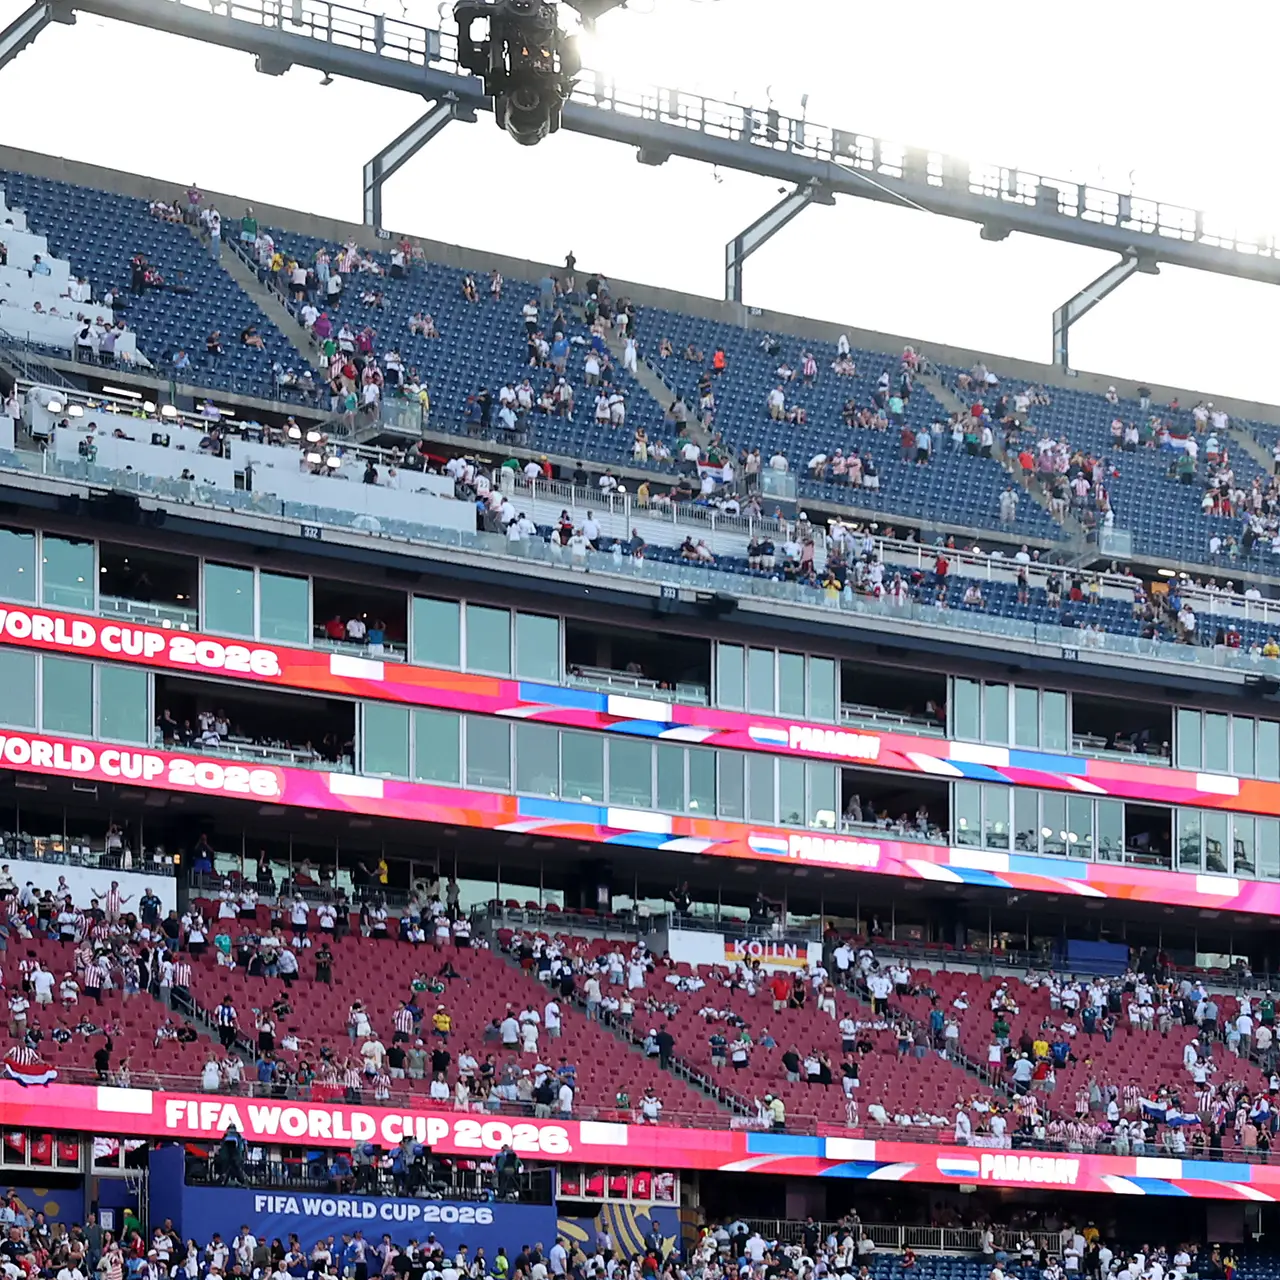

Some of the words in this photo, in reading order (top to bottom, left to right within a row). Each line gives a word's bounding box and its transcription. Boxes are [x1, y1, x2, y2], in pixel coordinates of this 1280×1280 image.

[304, 526, 318, 537] 332
[0, 609, 96, 648] ORLD
[101, 626, 165, 657] CUP
[169, 636, 279, 676] 2026
[0, 736, 96, 772] ORLD
[100, 749, 165, 780] CUP
[168, 758, 279, 796] 2026
[734, 937, 797, 960] KÖLN
[165, 1099, 242, 1132] FIFA
[247, 1105, 376, 1141] WORLD
[382, 1112, 449, 1146] CUP
[454, 1119, 569, 1154] 2026
[980, 1153, 1079, 1184] PARAGUAY
[255, 1194, 299, 1214] FIFA
[301, 1197, 377, 1219] WORLD
[380, 1202, 421, 1221] CUP
[424, 1206, 493, 1224] 2026
